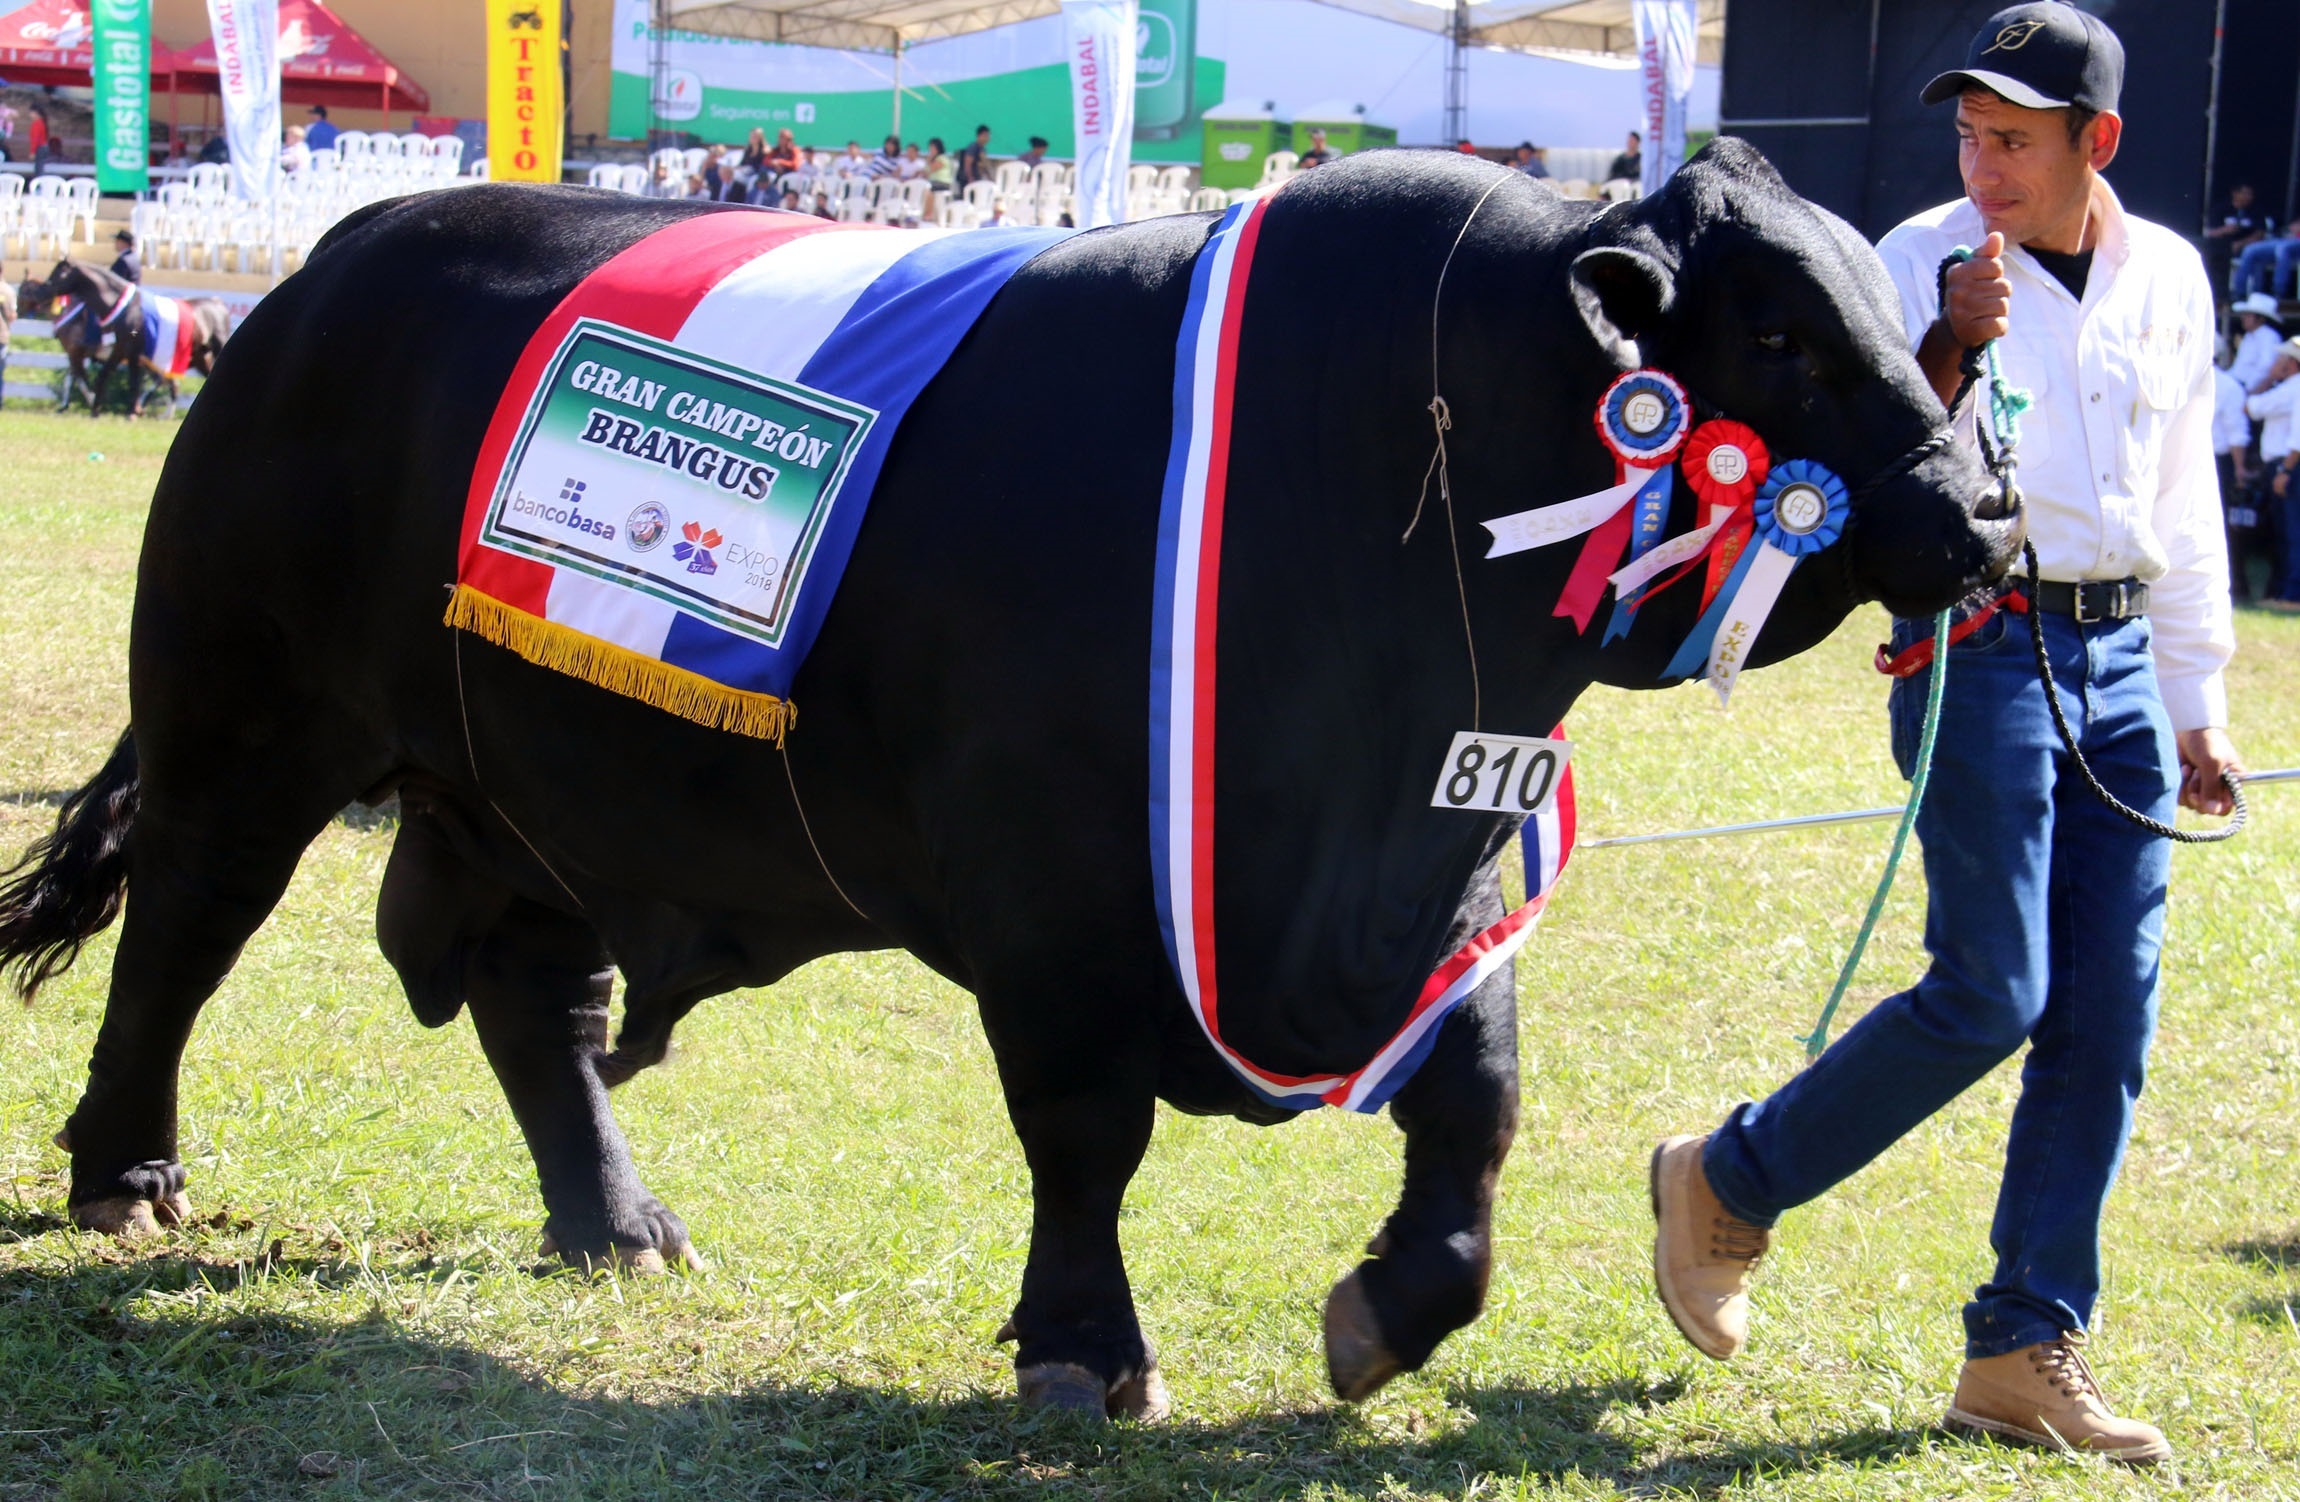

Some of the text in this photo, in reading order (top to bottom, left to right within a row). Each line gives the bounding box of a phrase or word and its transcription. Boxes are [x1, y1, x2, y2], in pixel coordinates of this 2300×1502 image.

[106, 29, 144, 171] Gastotal
[510, 37, 538, 171] Tracto
[1077, 35, 1100, 136] INDABAL
[1643, 35, 1665, 141] INDABAL
[570, 360, 833, 469] GRAN CAMPEÓN
[580, 410, 777, 501] BRANGUS
[512, 490, 616, 540] bancobasa
[725, 543, 779, 576] EXPO
[744, 572, 773, 591] 2018
[1715, 620, 1750, 678] EXPO
[1445, 743, 1557, 810] 810
